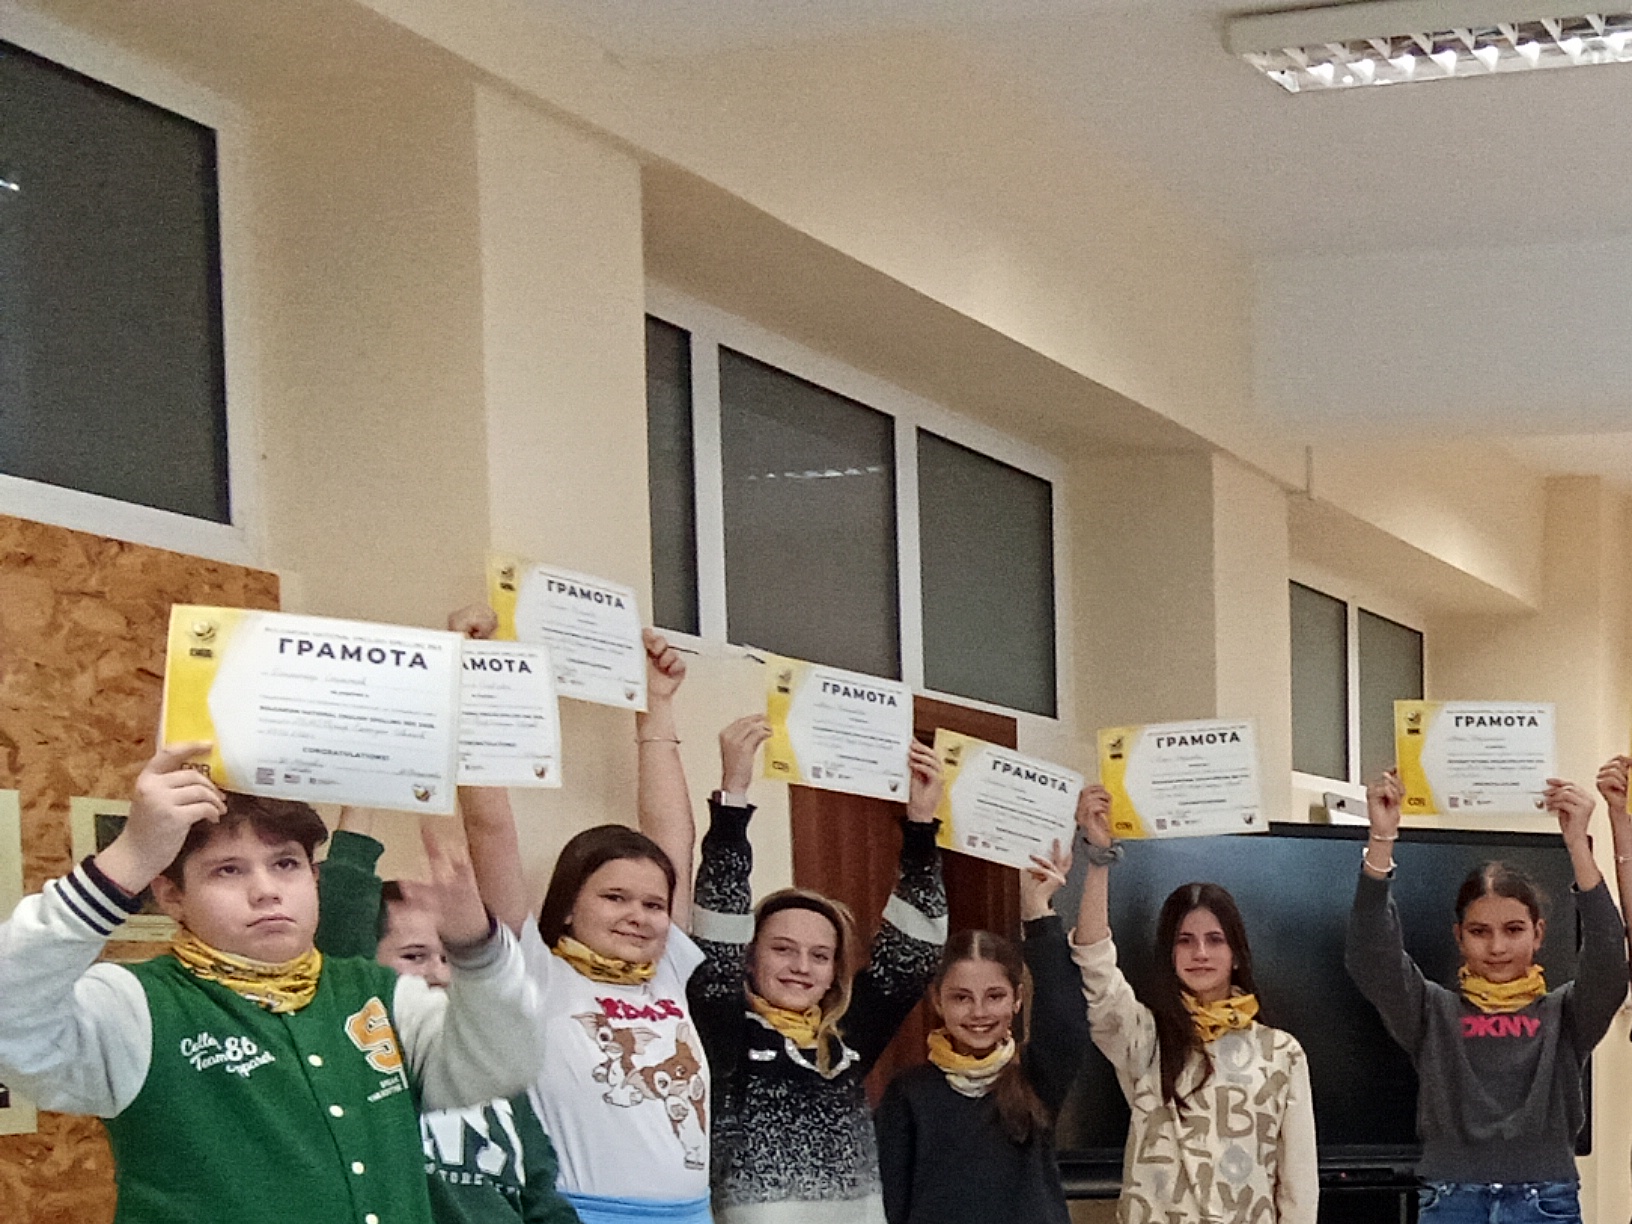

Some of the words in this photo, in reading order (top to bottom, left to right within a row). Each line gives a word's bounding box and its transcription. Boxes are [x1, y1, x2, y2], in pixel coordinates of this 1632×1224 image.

[547, 579, 626, 610] ГРАМОТА
[279, 637, 429, 670] ГРАМОТА
[822, 681, 898, 708] ГРАМОТА
[1455, 715, 1539, 728] ГРАМОТА
[1157, 730, 1241, 749] ГРАМОТА
[992, 759, 1069, 794] ГРАМОТА
[1460, 1014, 1541, 1038] DKNY
[225, 1035, 258, 1062] 86
